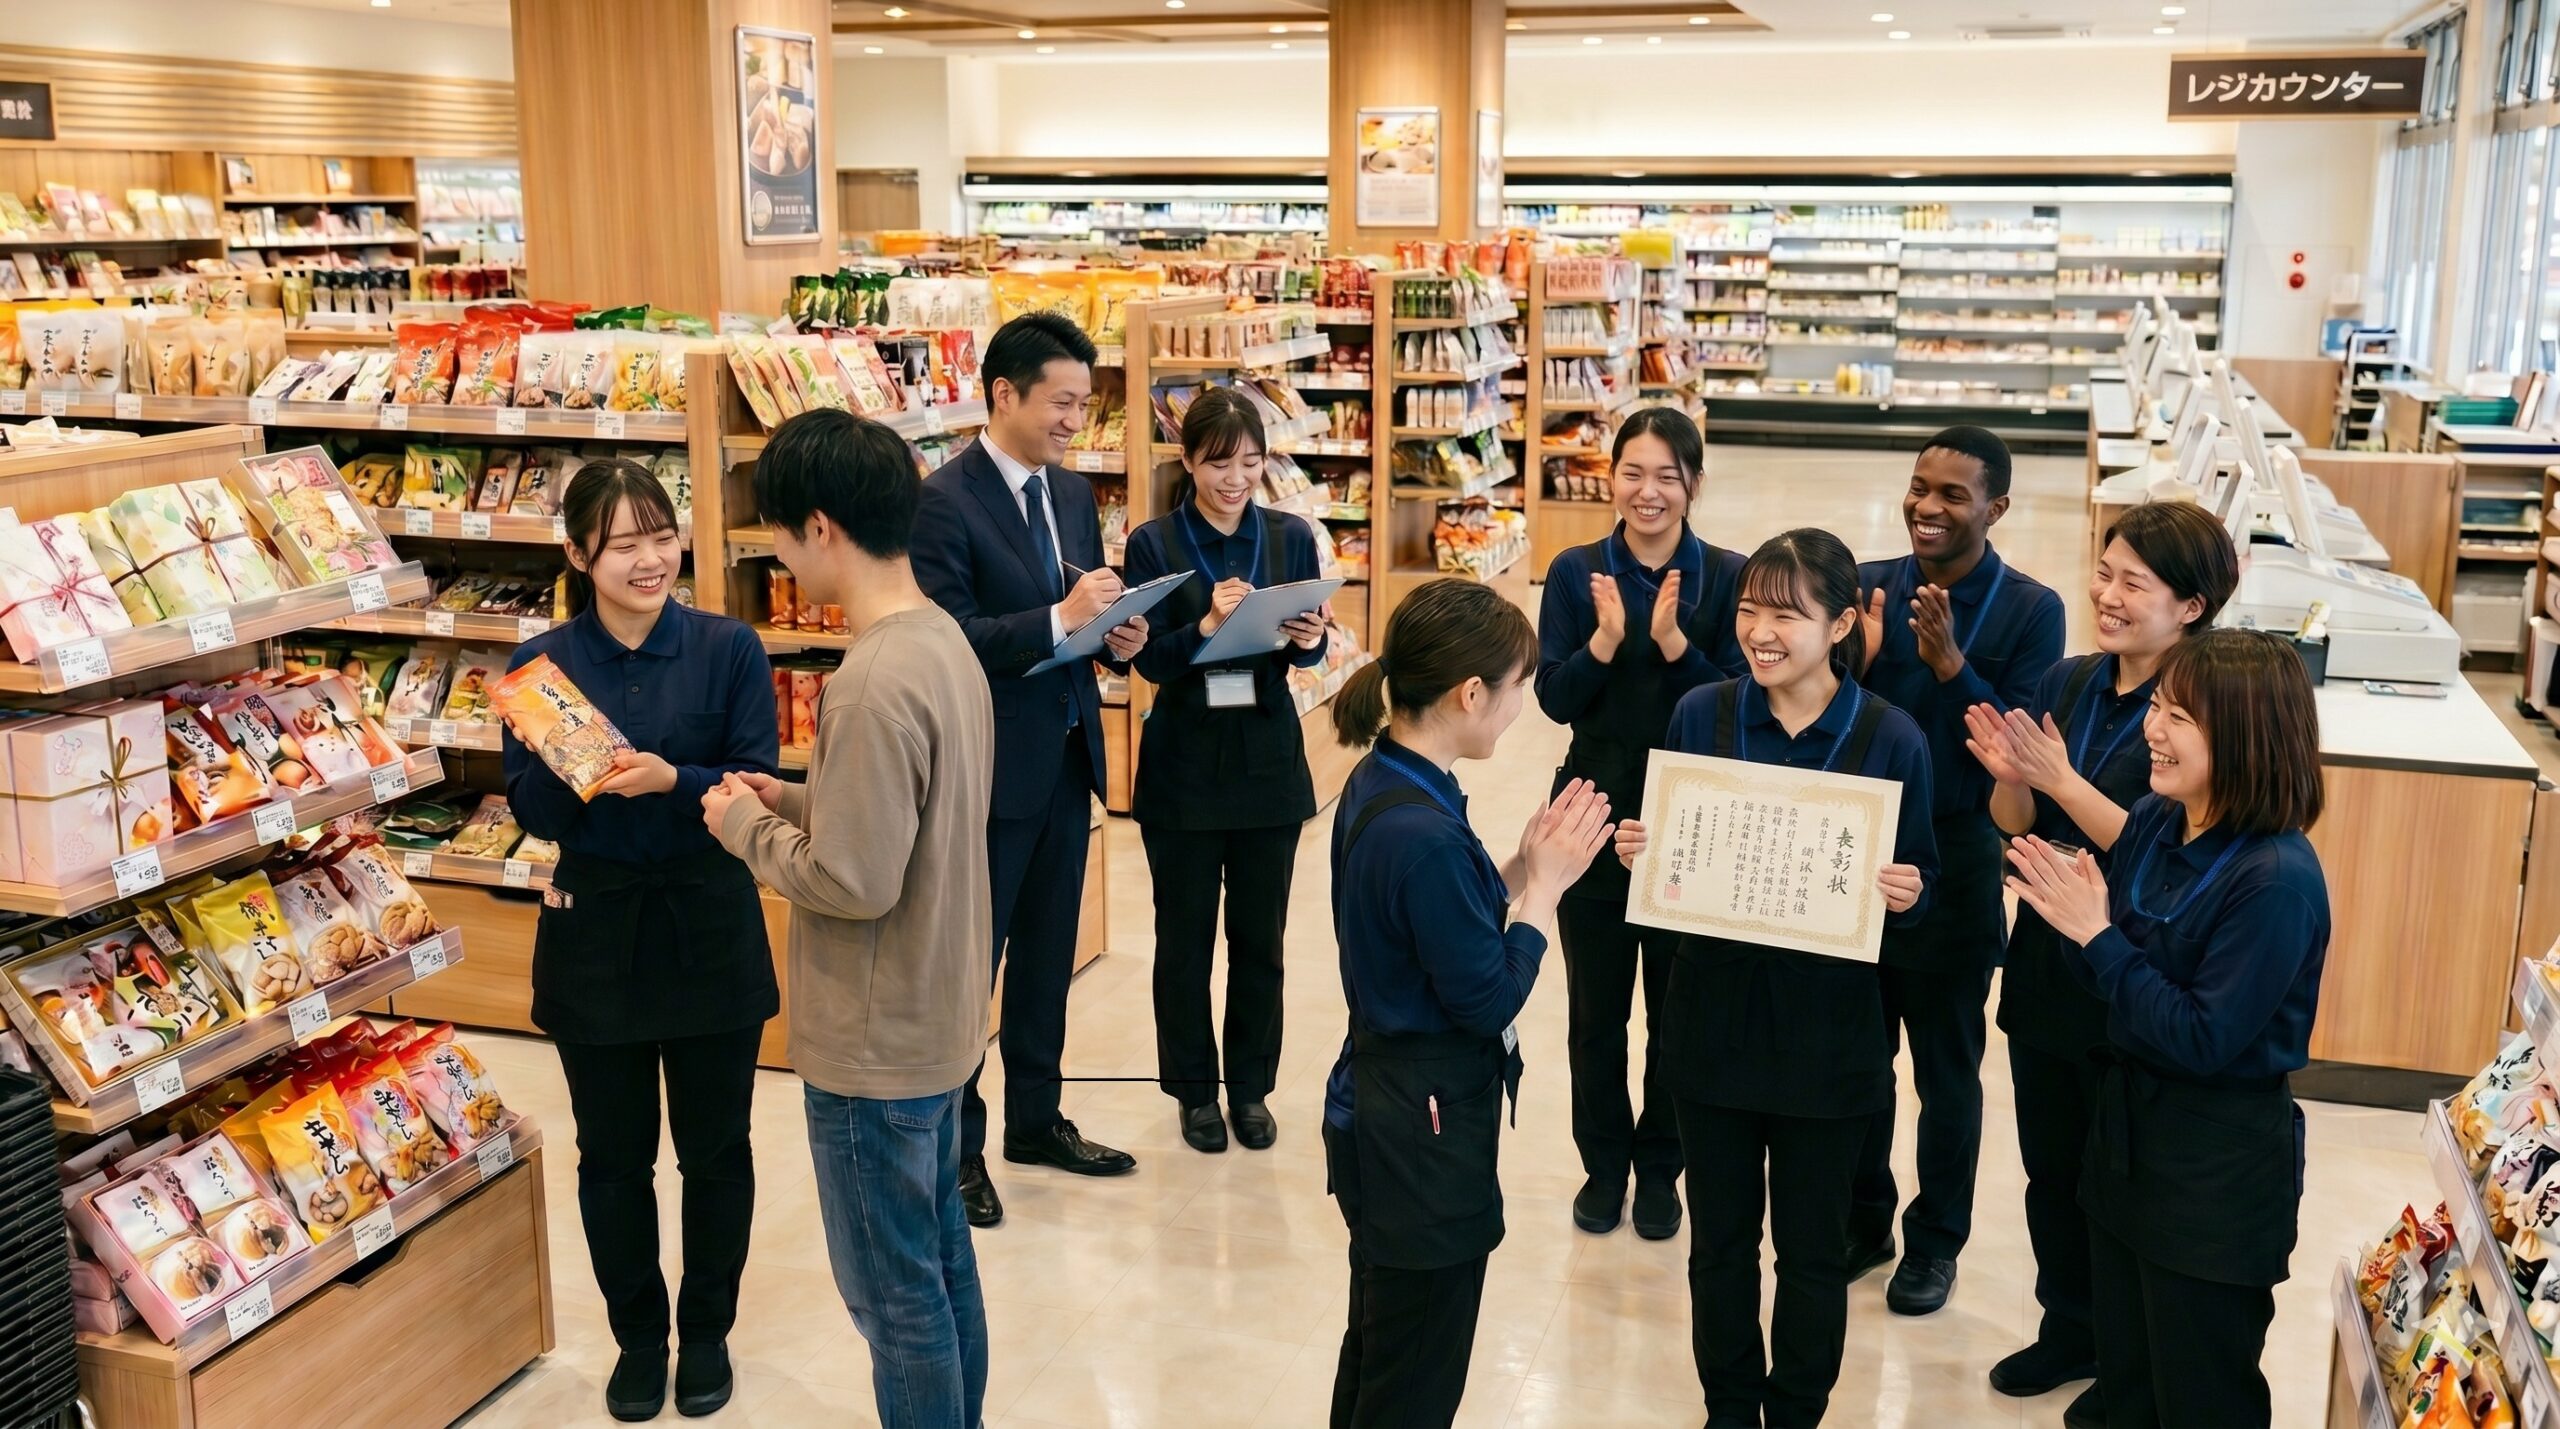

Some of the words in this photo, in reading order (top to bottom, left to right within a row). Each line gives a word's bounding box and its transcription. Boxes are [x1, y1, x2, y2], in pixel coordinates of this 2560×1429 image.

[2187, 70, 2404, 103] レジカウンター
[1827, 826, 1854, 895] 表彰状
